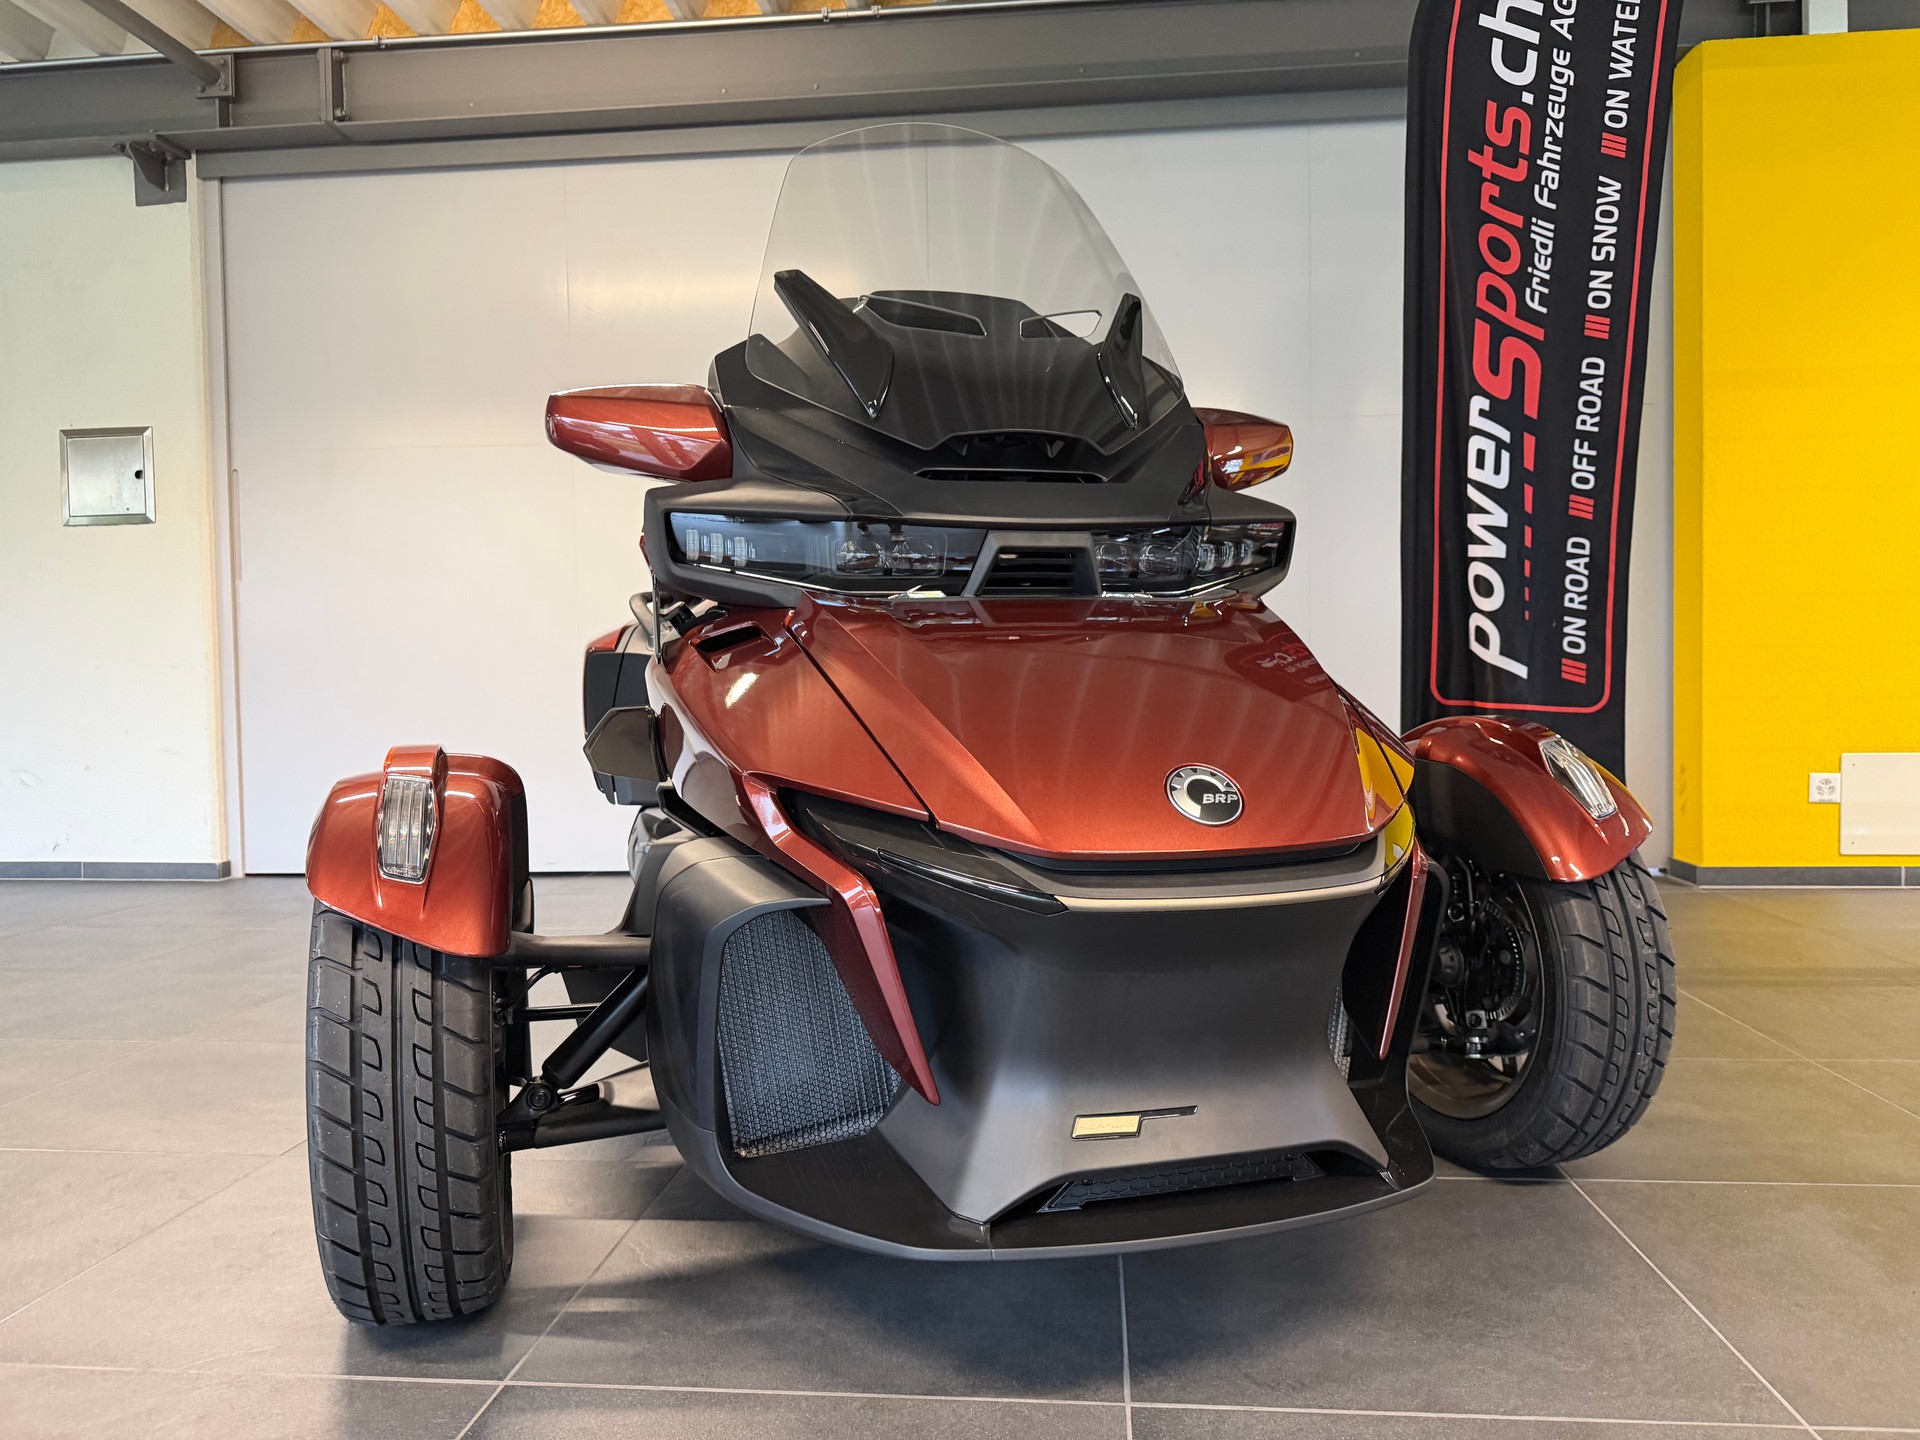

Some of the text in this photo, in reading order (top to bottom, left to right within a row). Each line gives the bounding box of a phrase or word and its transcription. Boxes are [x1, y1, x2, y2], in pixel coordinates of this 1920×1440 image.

[1605, 0, 1640, 129] ON WATE
[1525, 0, 1577, 313] Friedli Fahrzeuge AG
[1587, 175, 1622, 309] ON SNOW
[1571, 356, 1606, 490] OFF ROAD
[1562, 536, 1592, 655] ON ROAD
[1202, 793, 1238, 804] BRP
